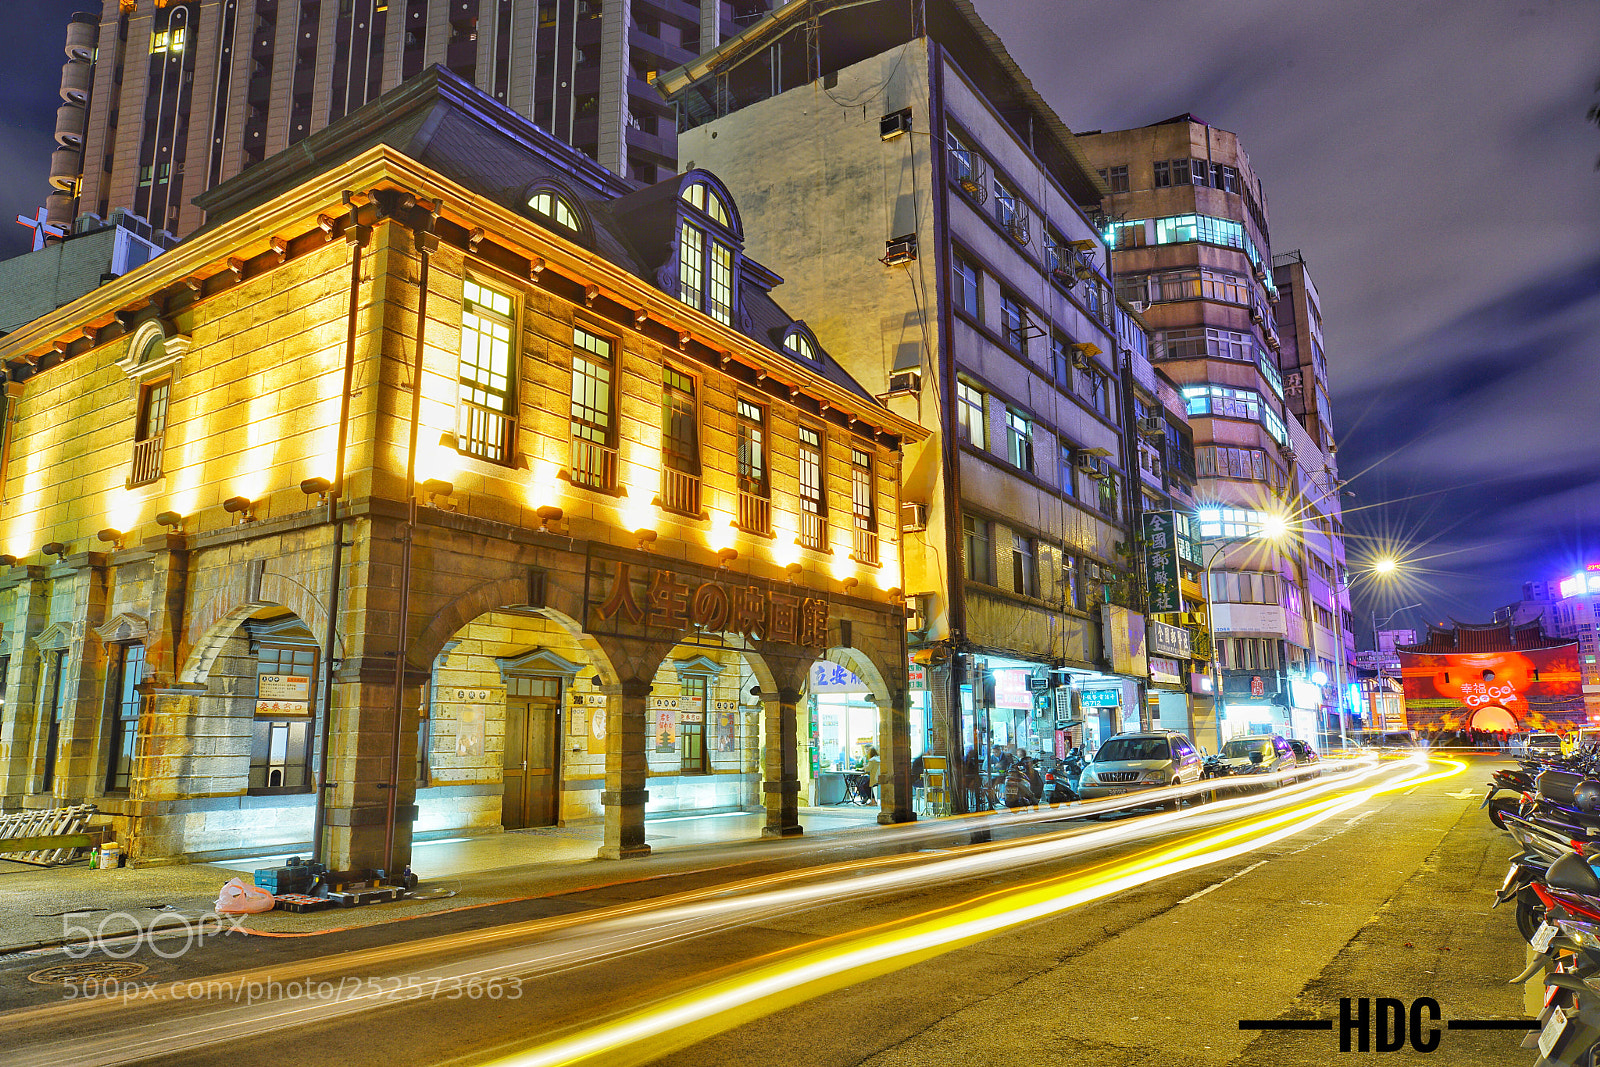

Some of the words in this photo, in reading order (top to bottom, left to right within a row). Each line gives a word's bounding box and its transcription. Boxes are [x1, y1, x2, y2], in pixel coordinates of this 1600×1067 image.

[596, 561, 830, 649] 人生の映画館
[1149, 514, 1173, 610] 全國郵幣社
[1460, 682, 1487, 694] 幸福
